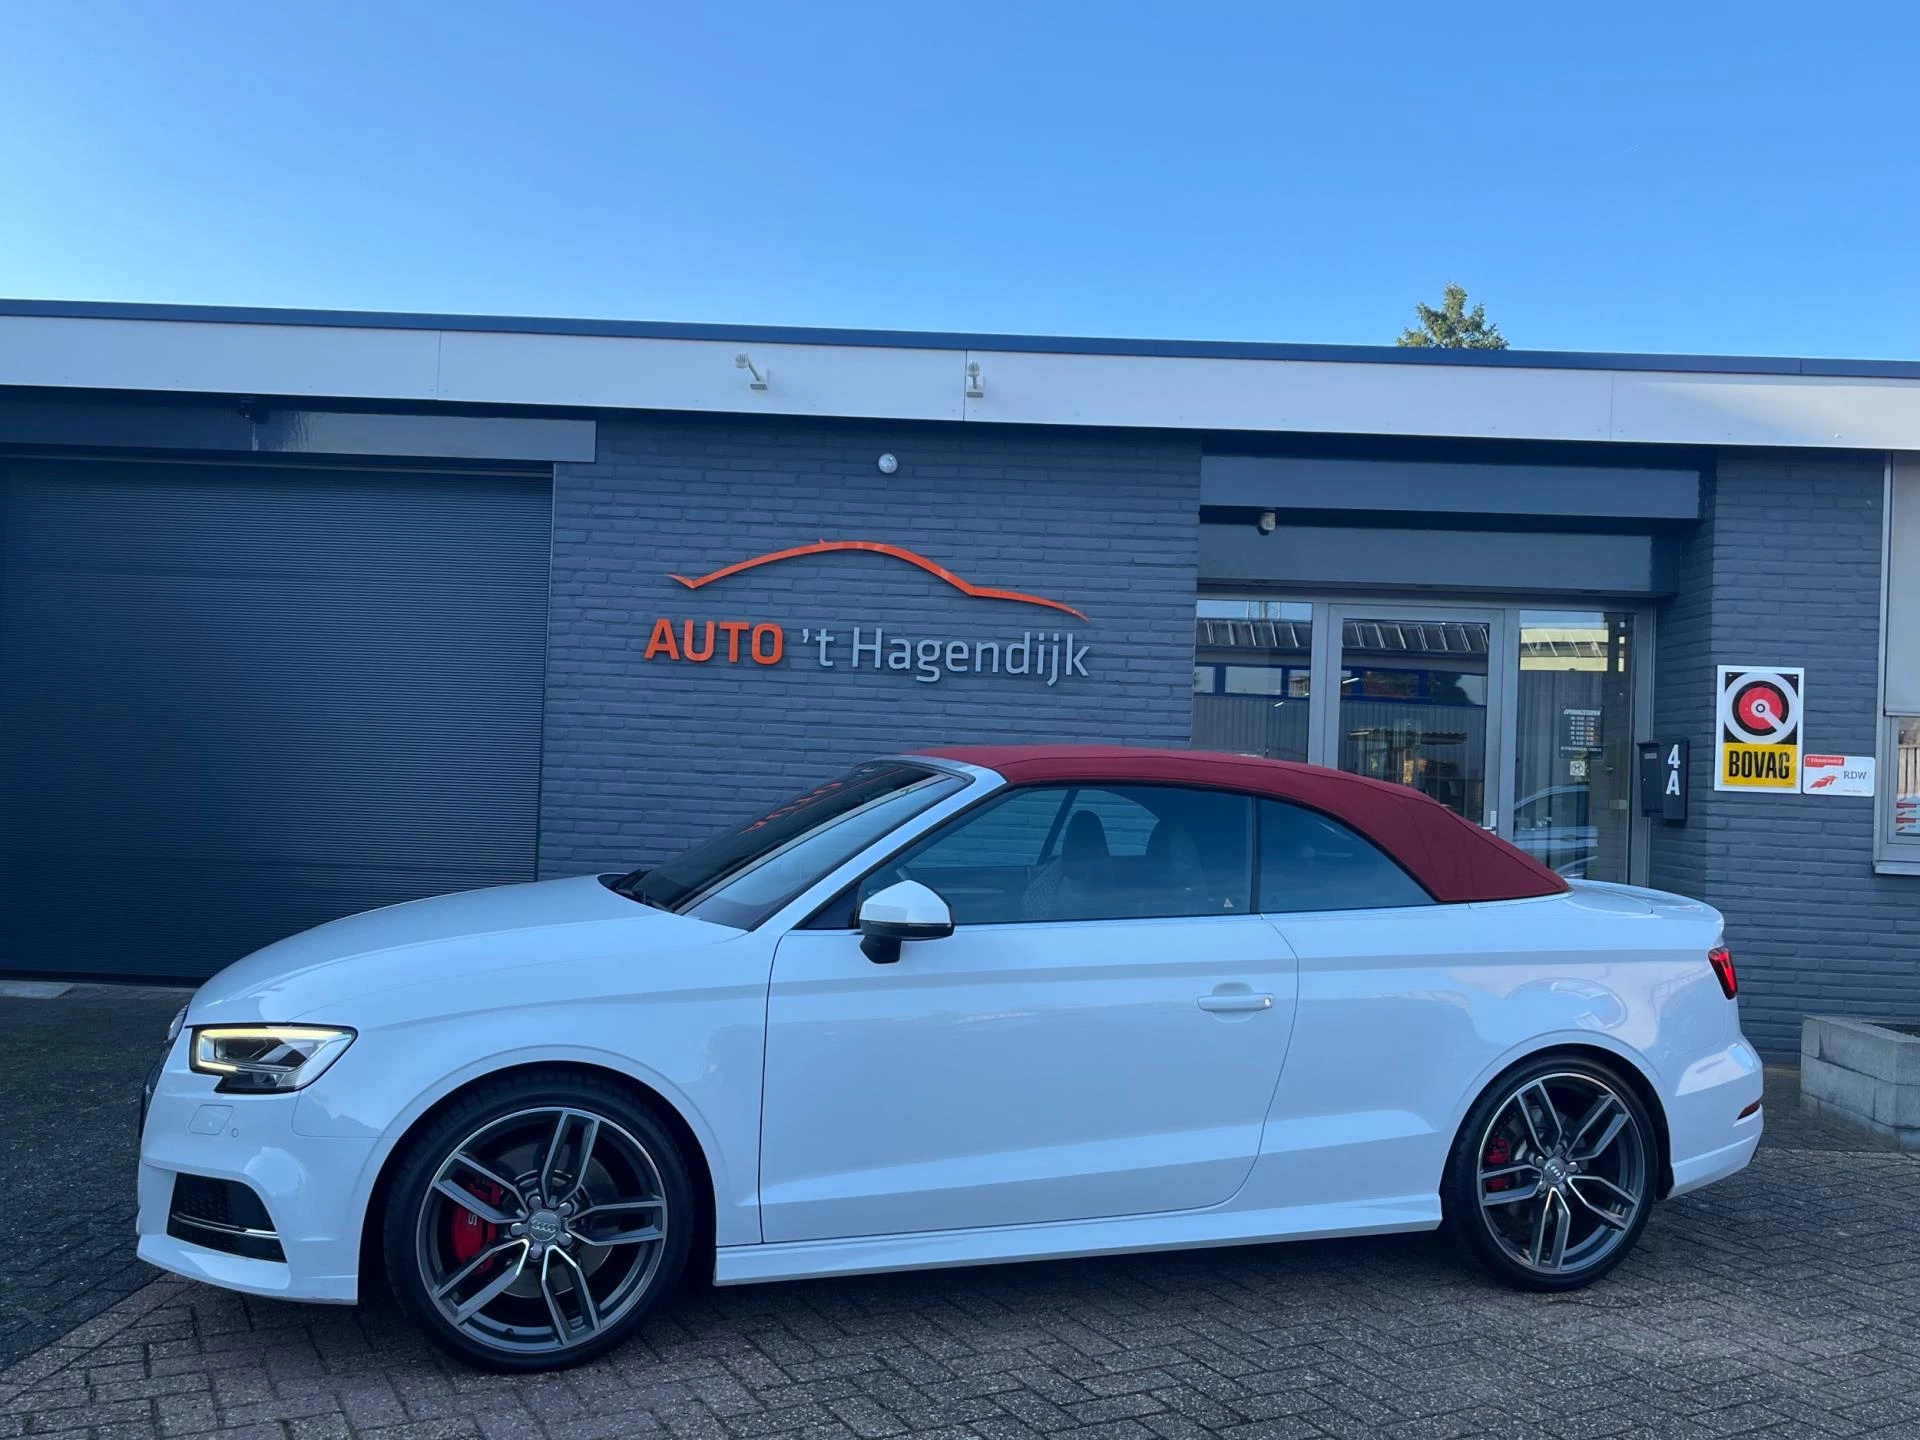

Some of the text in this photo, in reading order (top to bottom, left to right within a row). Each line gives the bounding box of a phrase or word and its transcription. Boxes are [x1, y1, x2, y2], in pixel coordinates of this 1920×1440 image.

[643, 617, 1091, 687] AUTO 't Hagendijk
[1667, 743, 1681, 769] 4
[1728, 750, 1791, 780] BOVAG
[1665, 769, 1681, 796] A
[1843, 770, 1867, 780] RDW
